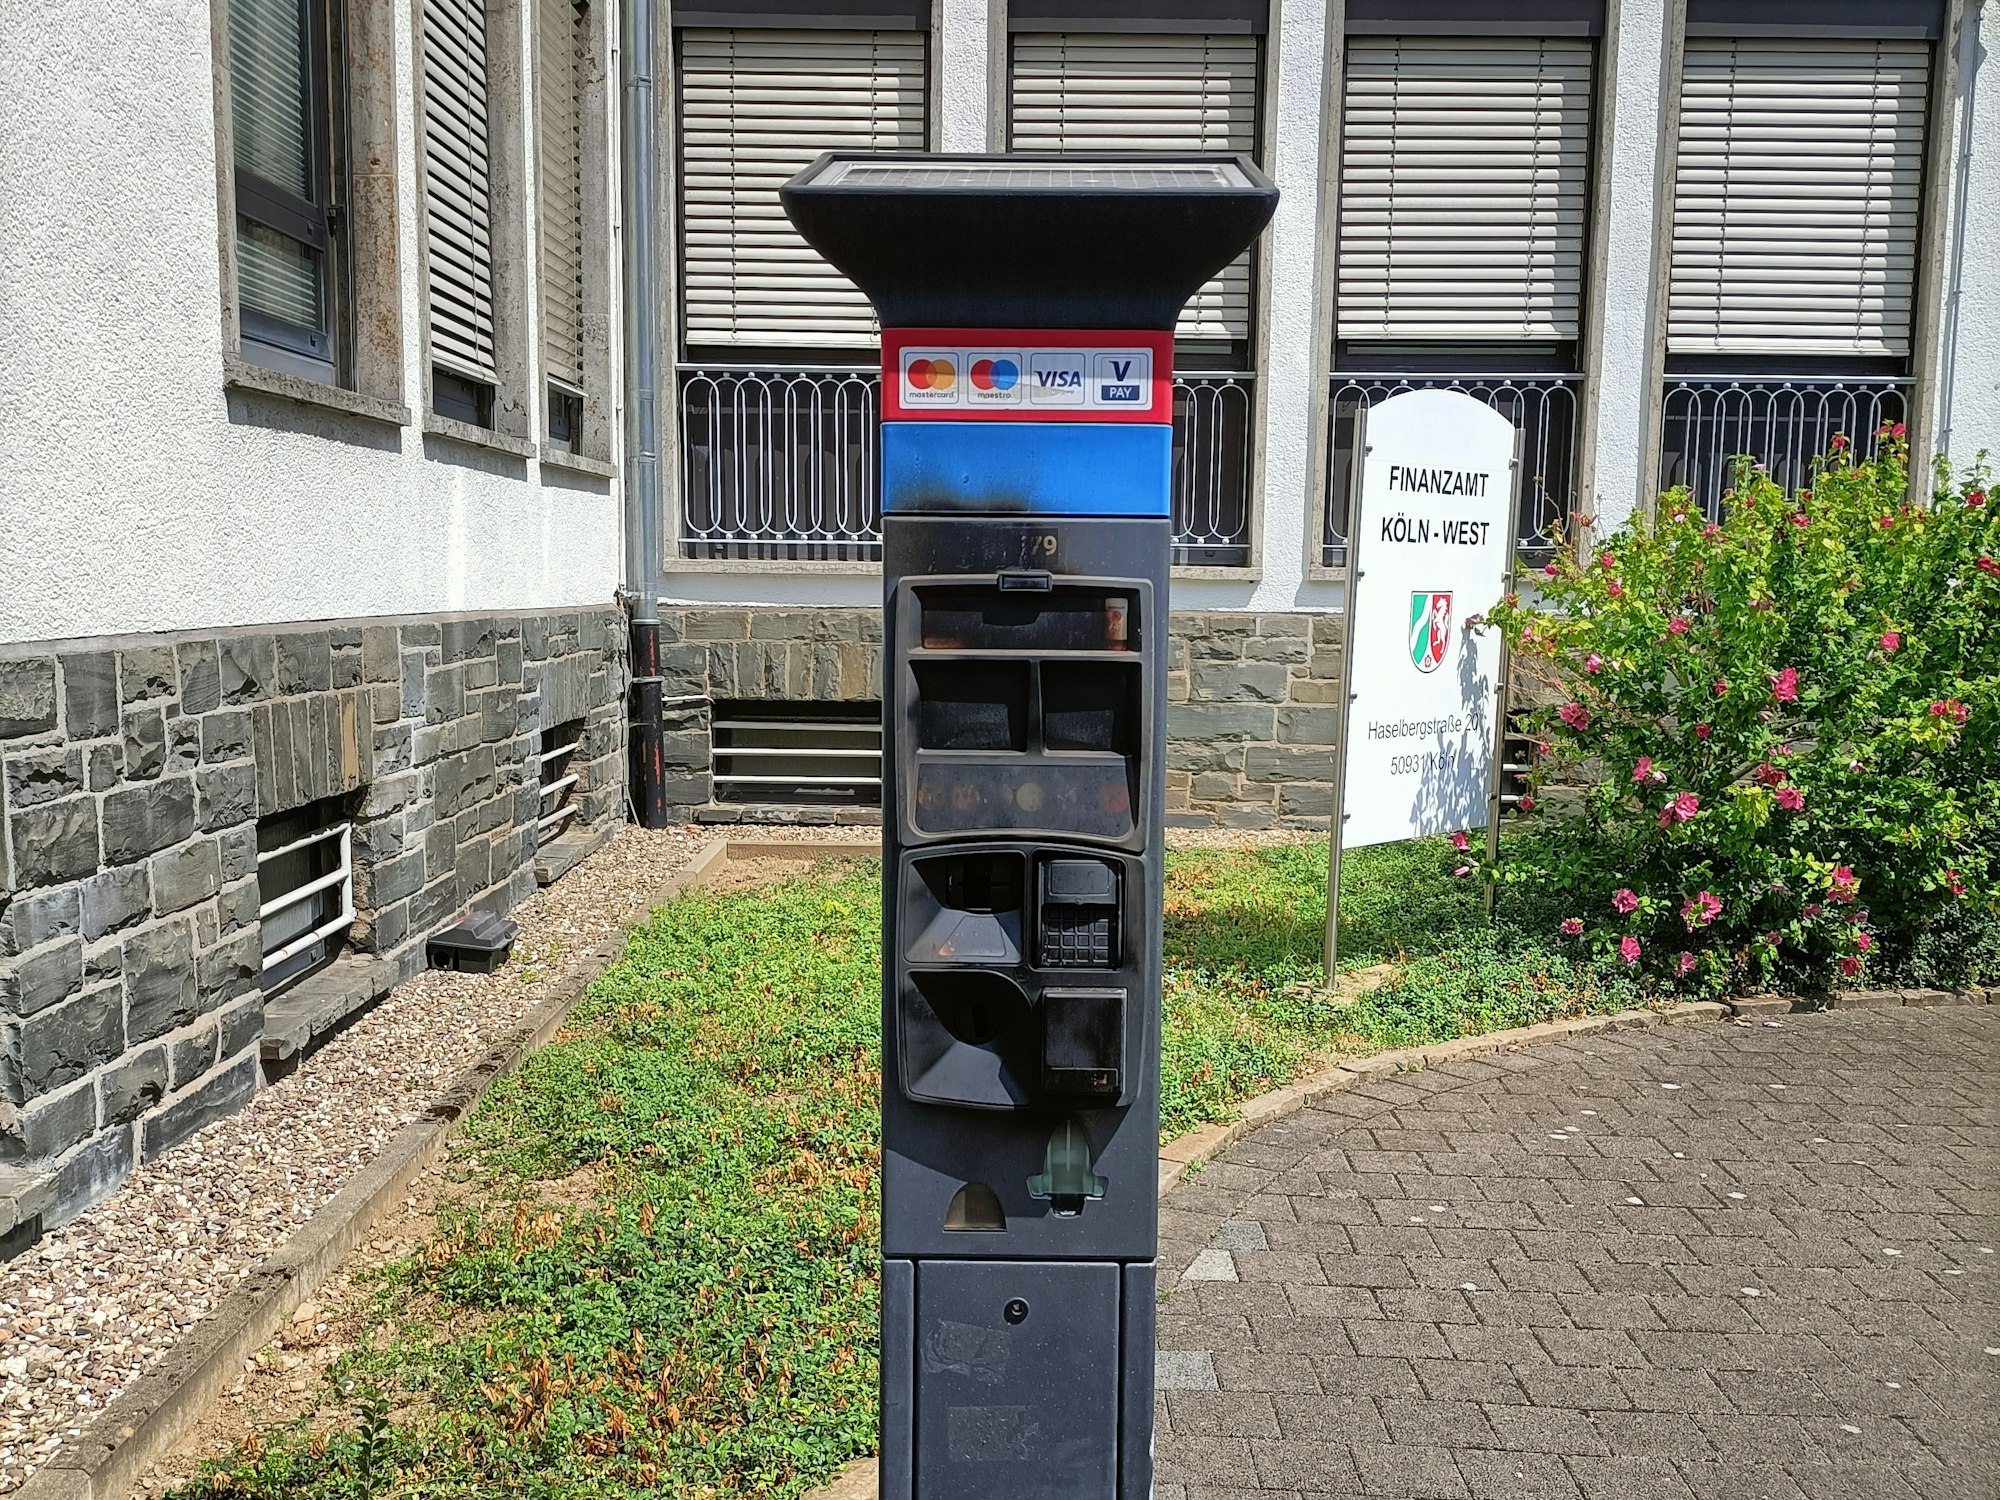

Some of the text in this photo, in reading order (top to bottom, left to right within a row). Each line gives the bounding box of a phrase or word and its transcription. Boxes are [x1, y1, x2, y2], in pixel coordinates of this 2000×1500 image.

[1034, 371, 1082, 388] VISA
[1109, 361, 1132, 382] V
[909, 390, 954, 399] mastercard
[977, 391, 1011, 400] maestro
[1109, 387, 1132, 399] PAY
[1389, 466, 1489, 497] FINANZAMT
[1368, 714, 1462, 740] Haselbergstraße
[1390, 751, 1455, 775] 50931 Köln
